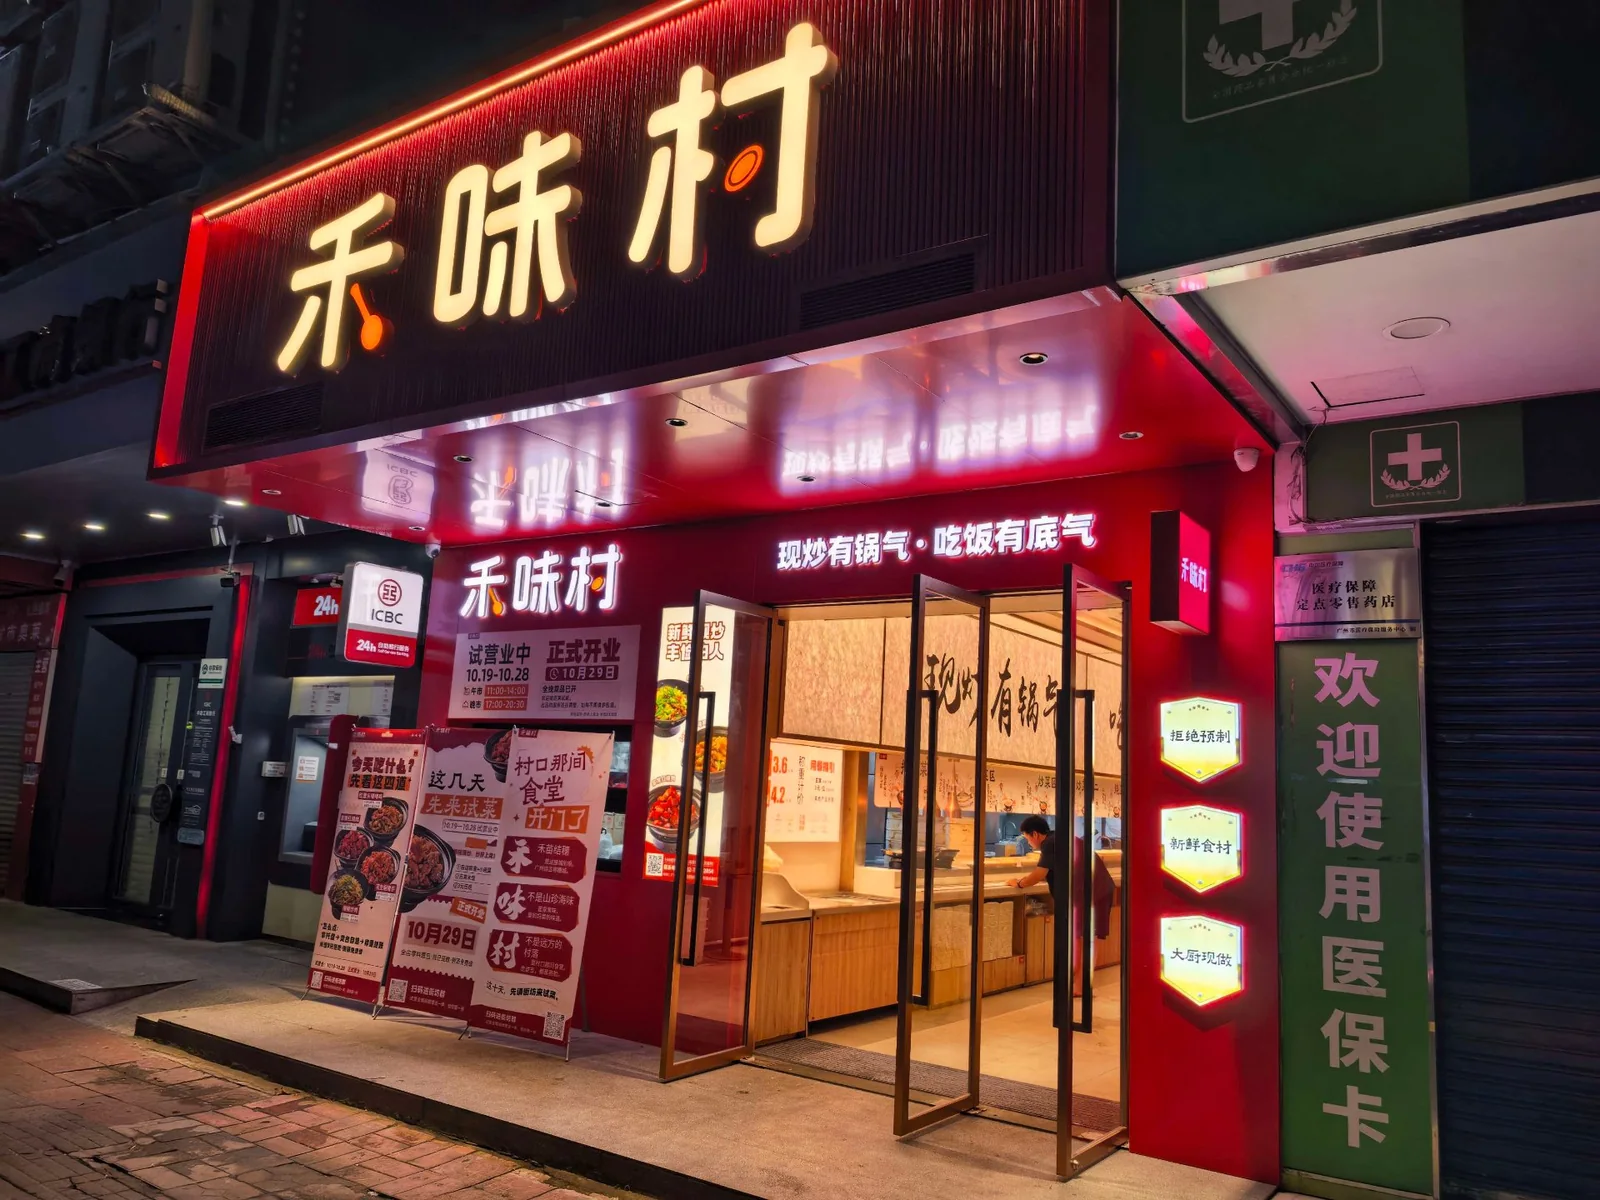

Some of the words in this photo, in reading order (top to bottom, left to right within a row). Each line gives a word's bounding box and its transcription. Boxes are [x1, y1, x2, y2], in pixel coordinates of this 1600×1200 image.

[277, 22, 836, 373] 禾味村
[776, 513, 1096, 571] 现炒有锅气·吃饭有底气
[460, 543, 623, 618] 禾味村
[1312, 579, 1377, 594] 医疗保障
[313, 594, 339, 617] 24h
[1296, 595, 1396, 611] 定点零售药店
[371, 608, 404, 625] ICBC
[356, 639, 376, 653] 24h
[468, 642, 531, 666] 试营业中
[546, 638, 621, 664] 正式开业
[466, 667, 530, 683] 10.19-10.28
[562, 666, 615, 680] 10月29日
[471, 687, 483, 696] 午市
[486, 685, 526, 696] 11:00-14:00
[469, 700, 482, 709] 晚市
[485, 699, 525, 709] 17:00-20:30
[1170, 728, 1231, 744] 拒绝预制
[514, 751, 586, 776] 村口那间
[349, 773, 407, 791] 先看这四道
[428, 769, 486, 792] 这几天
[519, 774, 565, 806] 食堂
[425, 795, 498, 819] 先来试菜
[528, 807, 586, 831] 开门了
[505, 838, 533, 874] 禾
[1169, 836, 1233, 855] 新鲜食材
[496, 884, 526, 921] 味
[527, 891, 575, 906] 不是山珍海味
[1314, 652, 1390, 1148] 欢迎使用医保卡
[457, 900, 486, 919] 正式开业
[408, 921, 477, 950] 10月29日
[525, 936, 563, 950] 不是远方的
[490, 931, 520, 970] 村
[523, 948, 540, 960] 村落
[1170, 947, 1233, 967] 大厨现做
